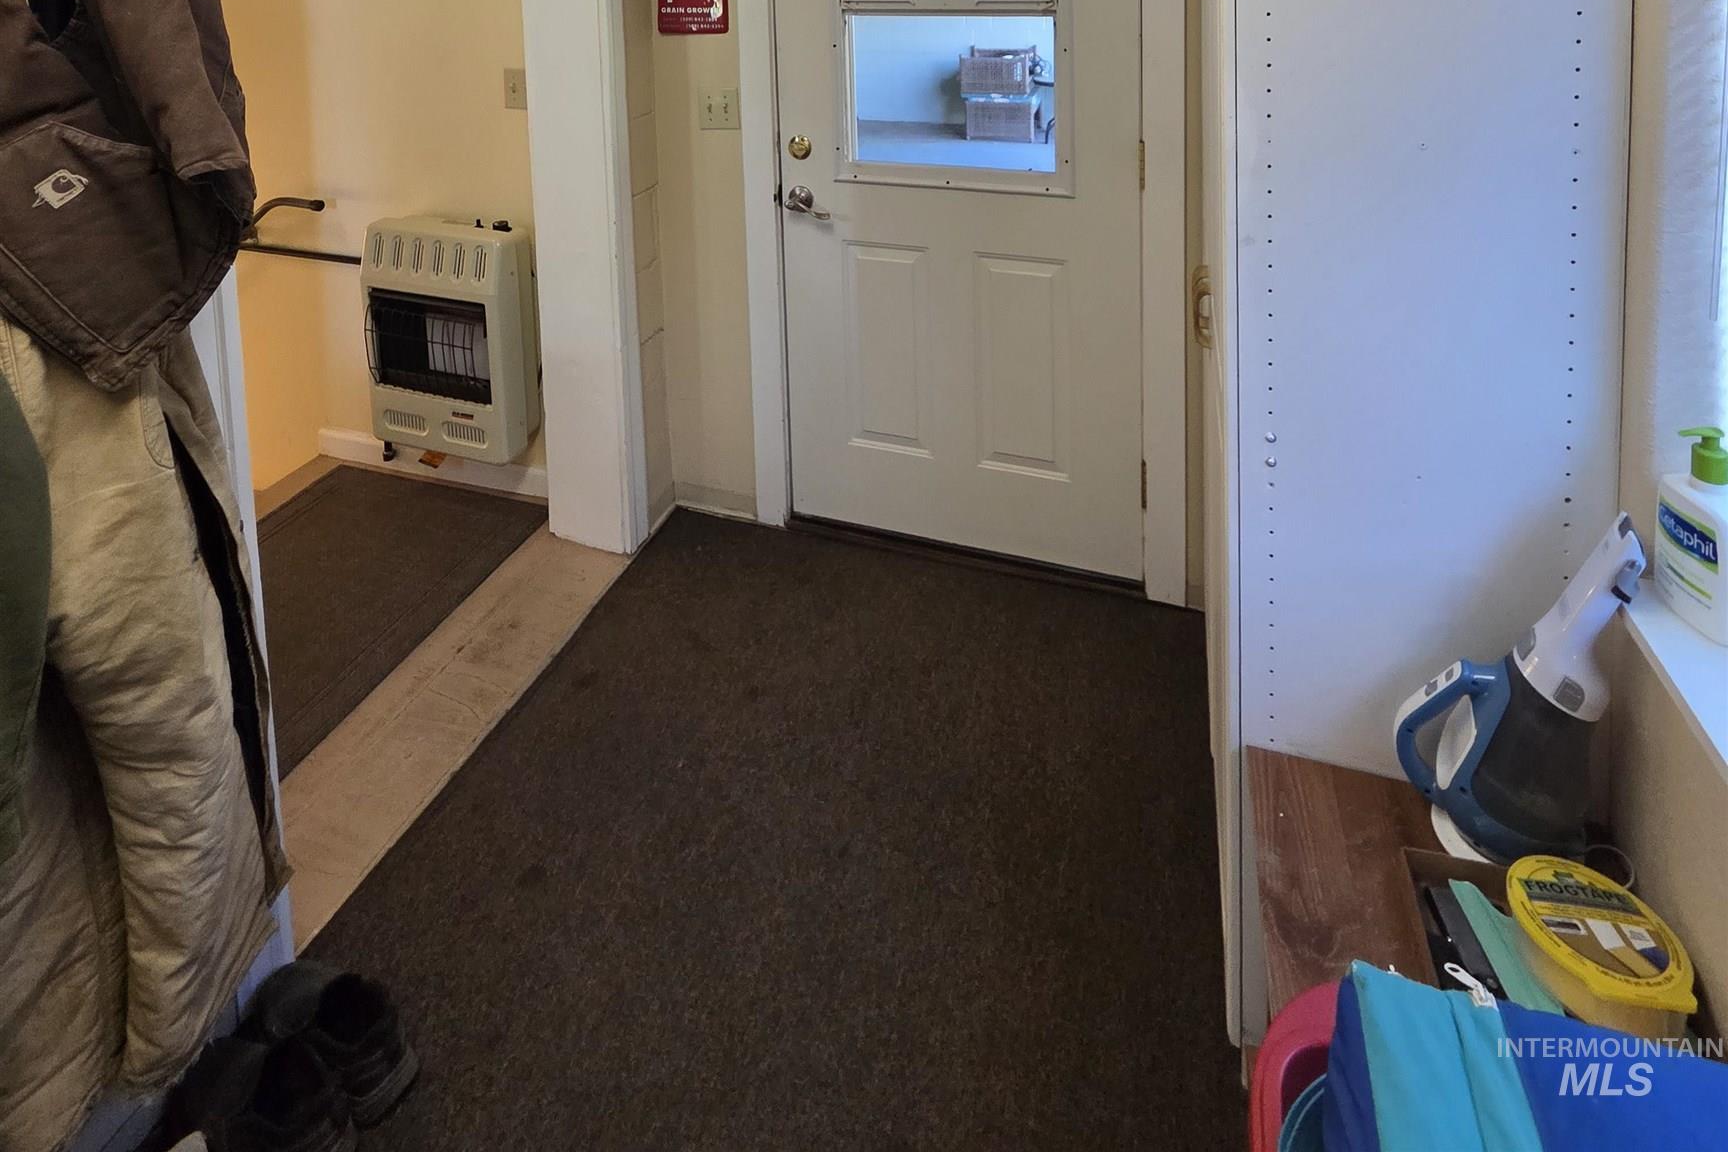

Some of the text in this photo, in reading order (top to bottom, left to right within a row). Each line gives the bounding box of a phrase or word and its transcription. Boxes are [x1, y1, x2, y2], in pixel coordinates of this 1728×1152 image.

[661, 6, 685, 14] GRAIN
[1659, 505, 1716, 561] Cetaphil
[1524, 881, 1629, 906] FROGTAPE
